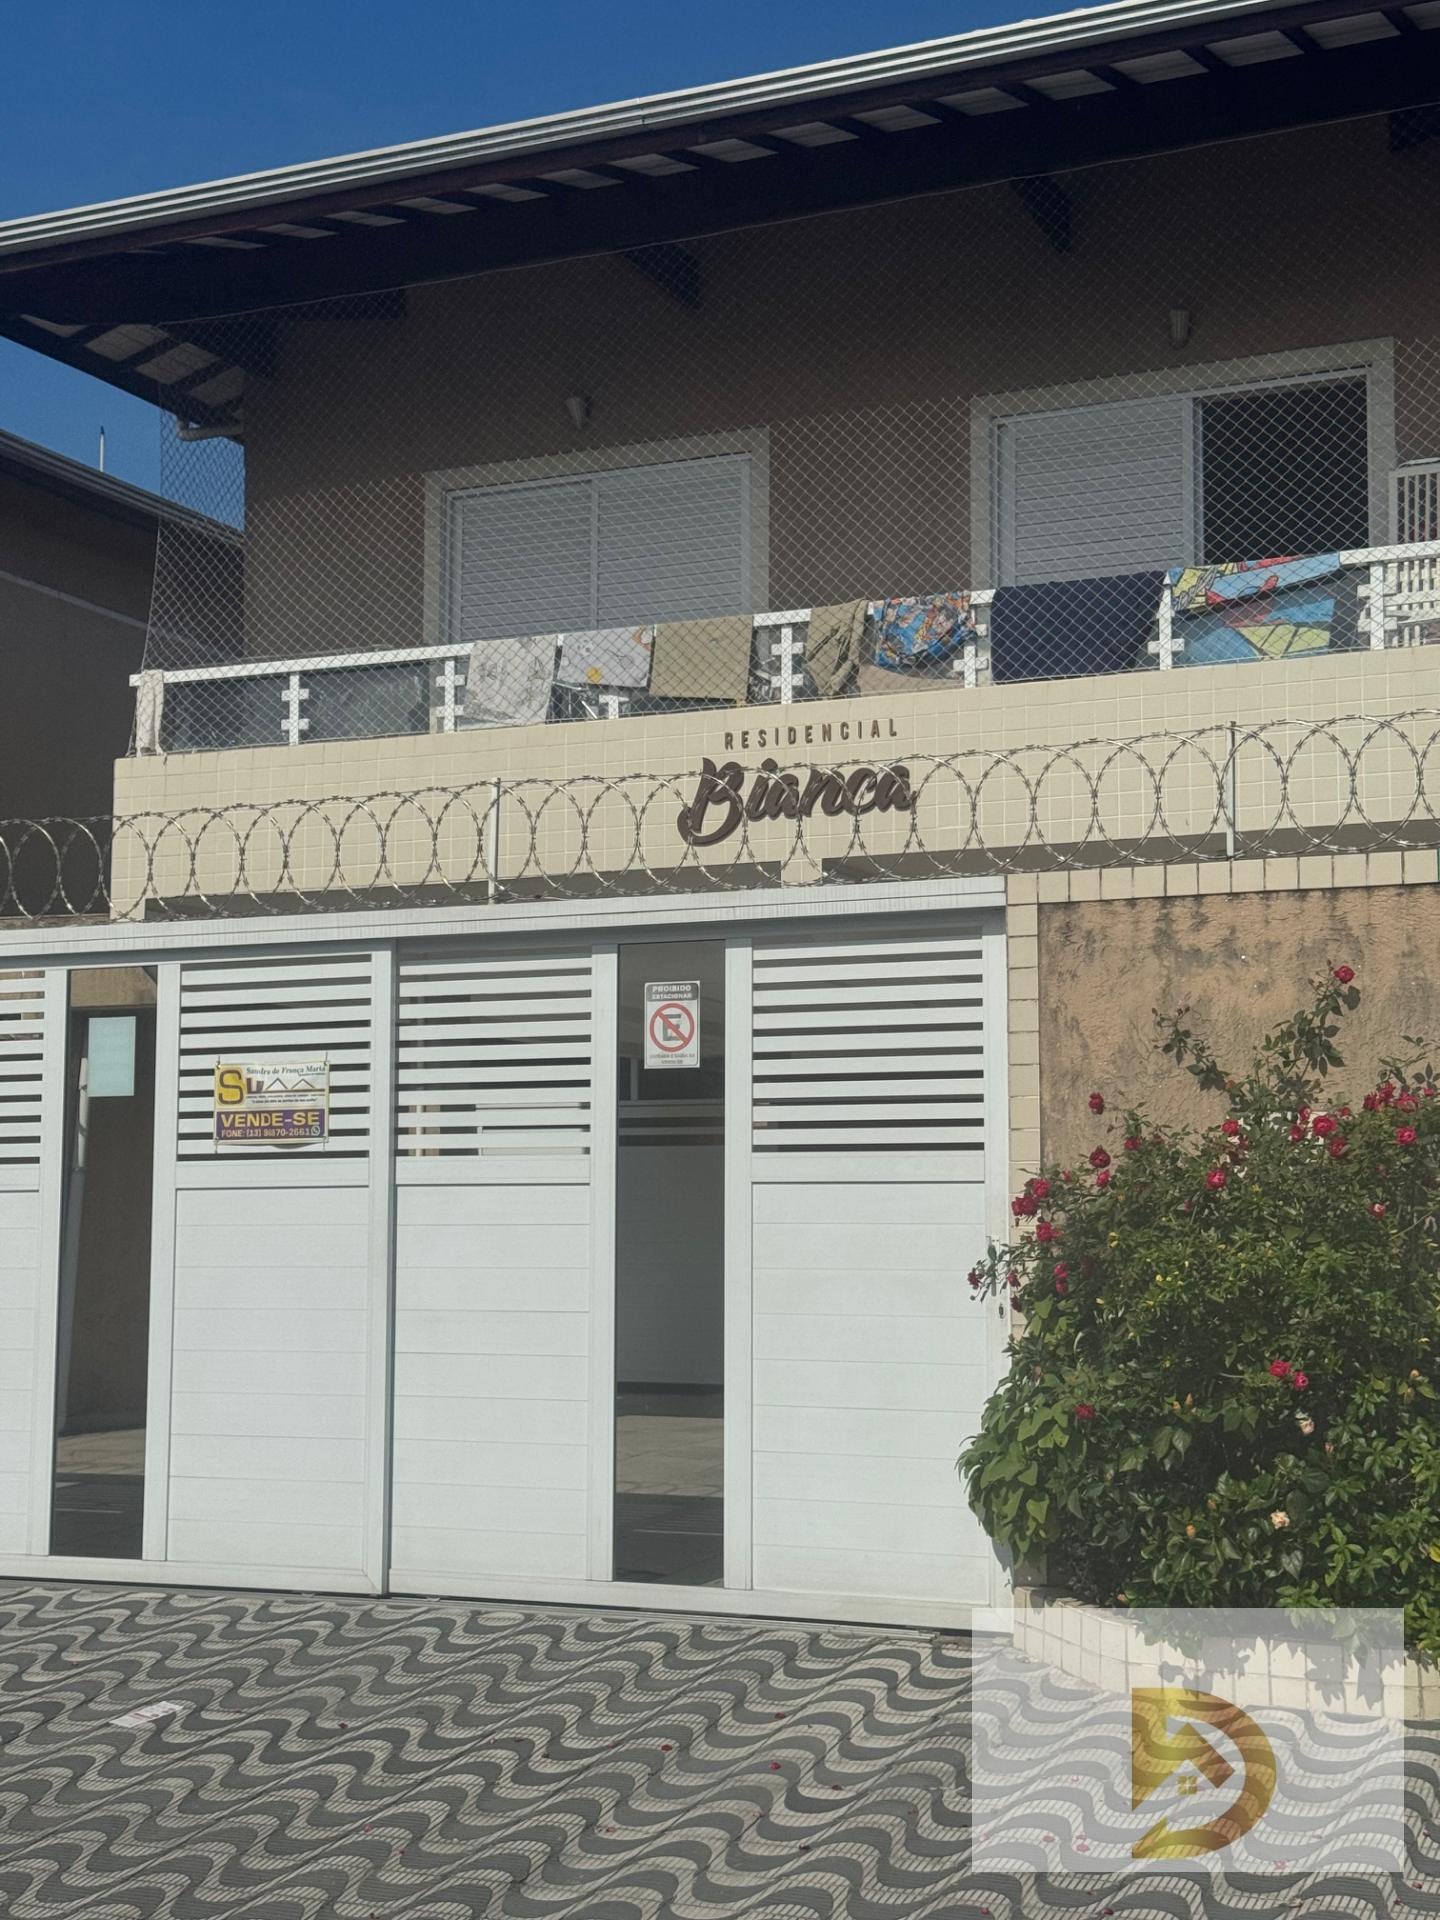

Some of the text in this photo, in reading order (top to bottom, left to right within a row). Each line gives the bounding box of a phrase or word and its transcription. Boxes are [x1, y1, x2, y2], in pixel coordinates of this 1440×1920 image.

[724, 718, 898, 750] RESIDENCIAL
[676, 756, 914, 847] Bianca
[651, 992, 692, 1000] ESTACIONAR
[652, 984, 692, 993] PROIBIDO
[220, 1111, 320, 1128] VENDE-SE
